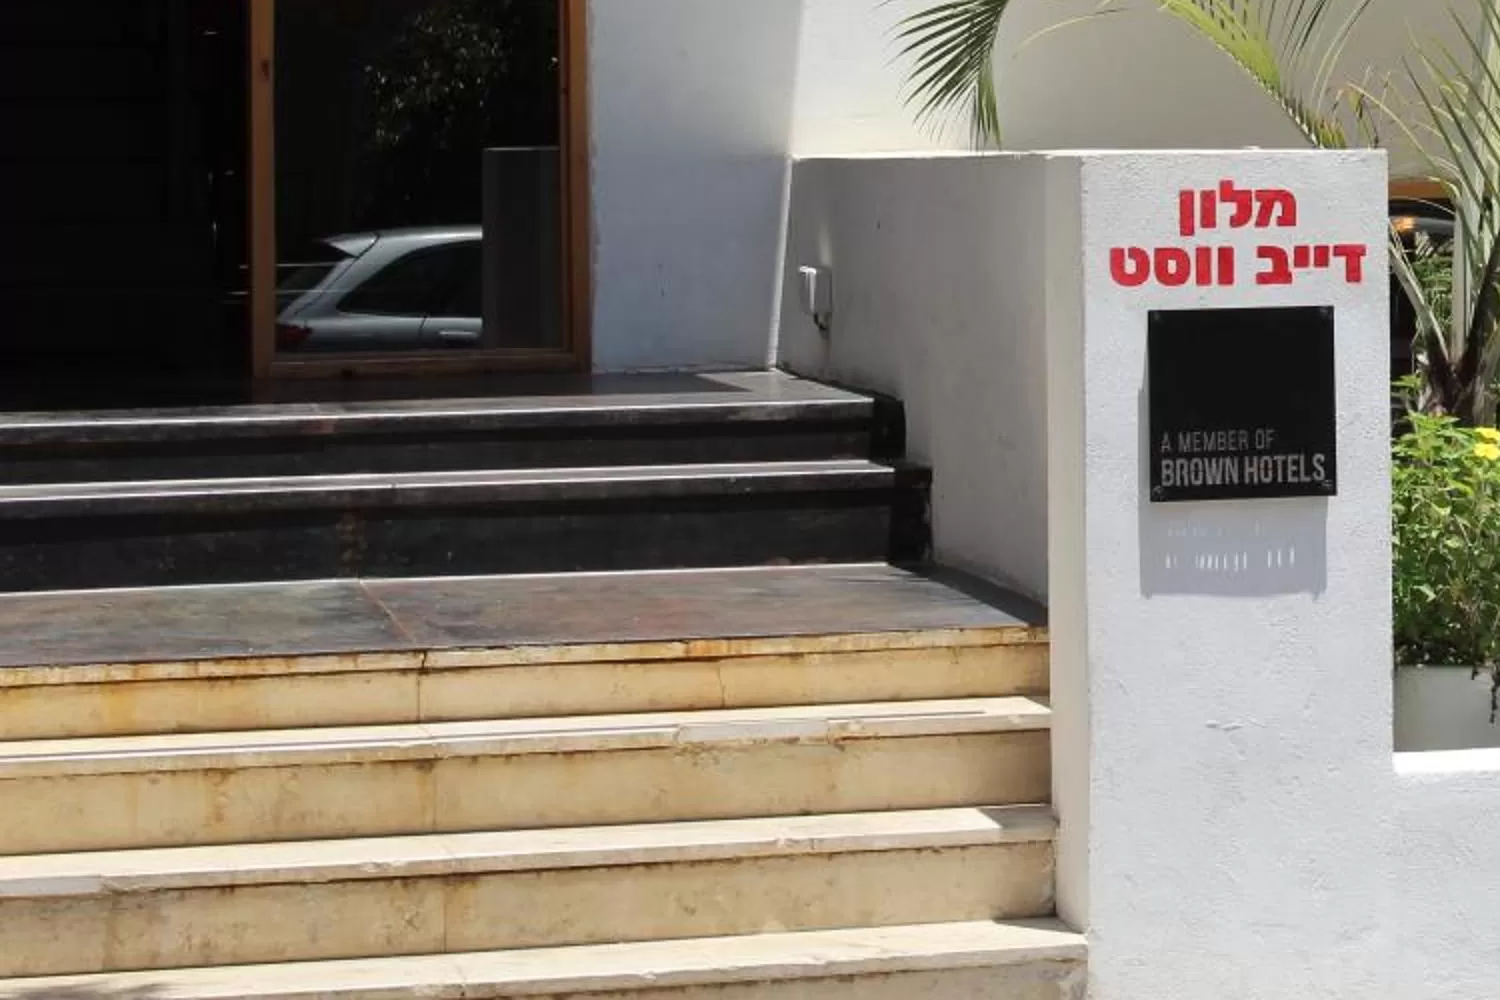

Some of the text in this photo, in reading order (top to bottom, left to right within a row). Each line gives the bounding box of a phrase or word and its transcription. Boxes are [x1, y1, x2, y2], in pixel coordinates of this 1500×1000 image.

[1179, 180, 1297, 236] מלון
[1109, 244, 1367, 287] דייב ווסט
[1161, 428, 1275, 452] A MEMBER OF
[1161, 453, 1326, 486] BROWN HOTELS
